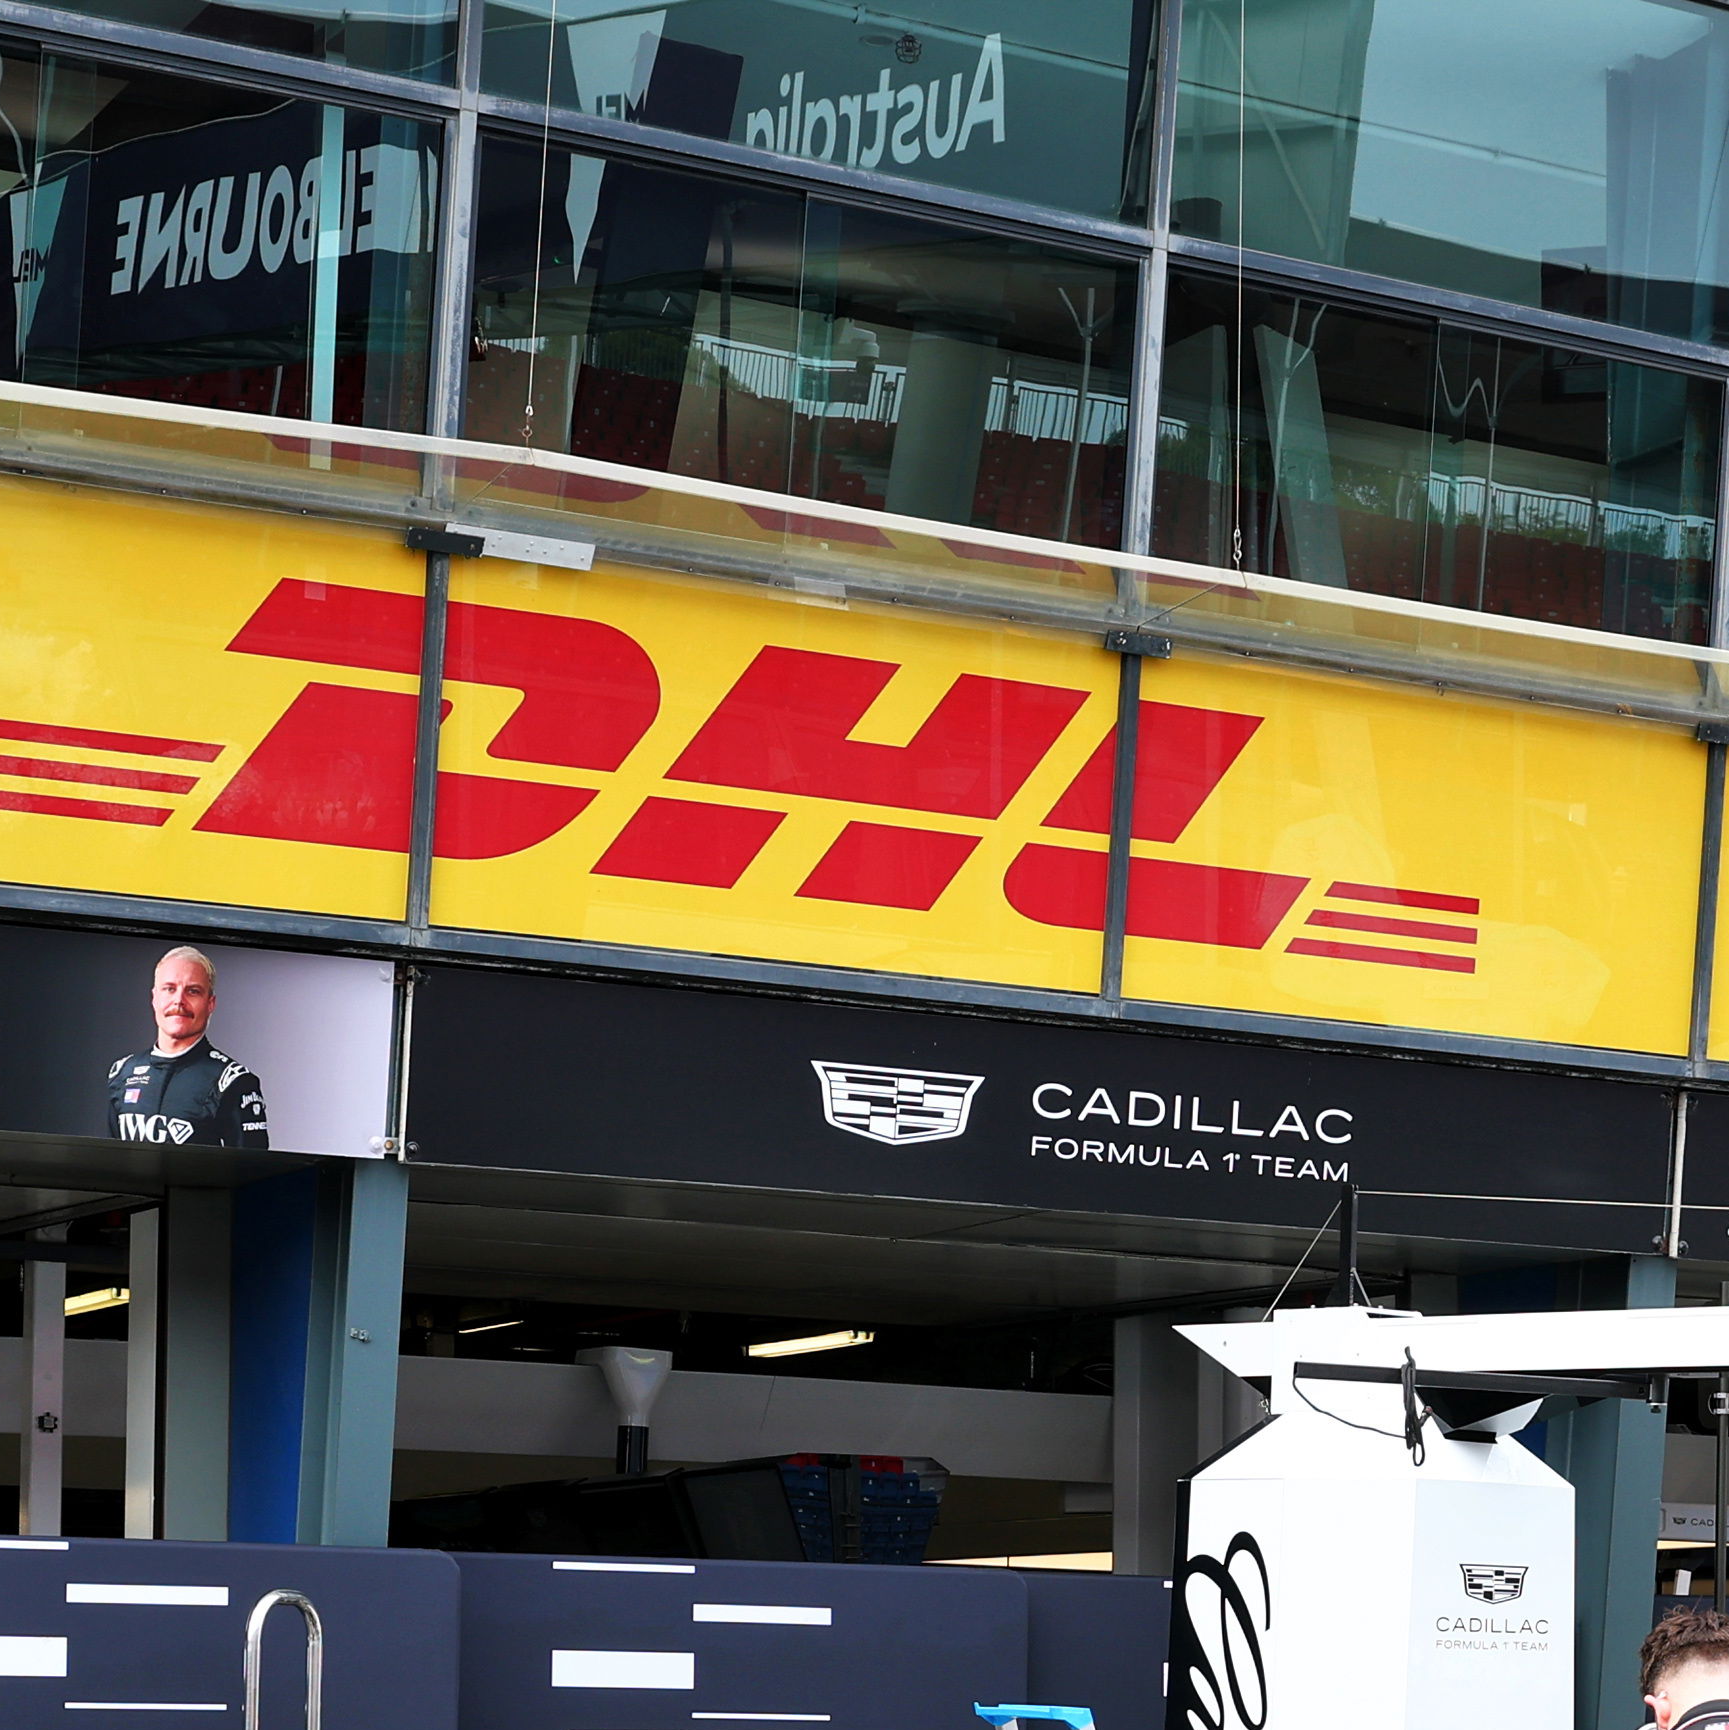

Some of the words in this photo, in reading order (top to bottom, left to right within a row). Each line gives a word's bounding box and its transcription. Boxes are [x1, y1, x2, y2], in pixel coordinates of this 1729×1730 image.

[191, 577, 1310, 950] DHL
[1032, 1082, 1354, 1145] CADILLAC
[1031, 1136, 1209, 1172] FORMULA
[1254, 1154, 1349, 1183] TEAM
[1436, 1616, 1549, 1635] CADILLAC
[1436, 1640, 1499, 1650] FORMULA
[1514, 1641, 1548, 1651] TEAM
